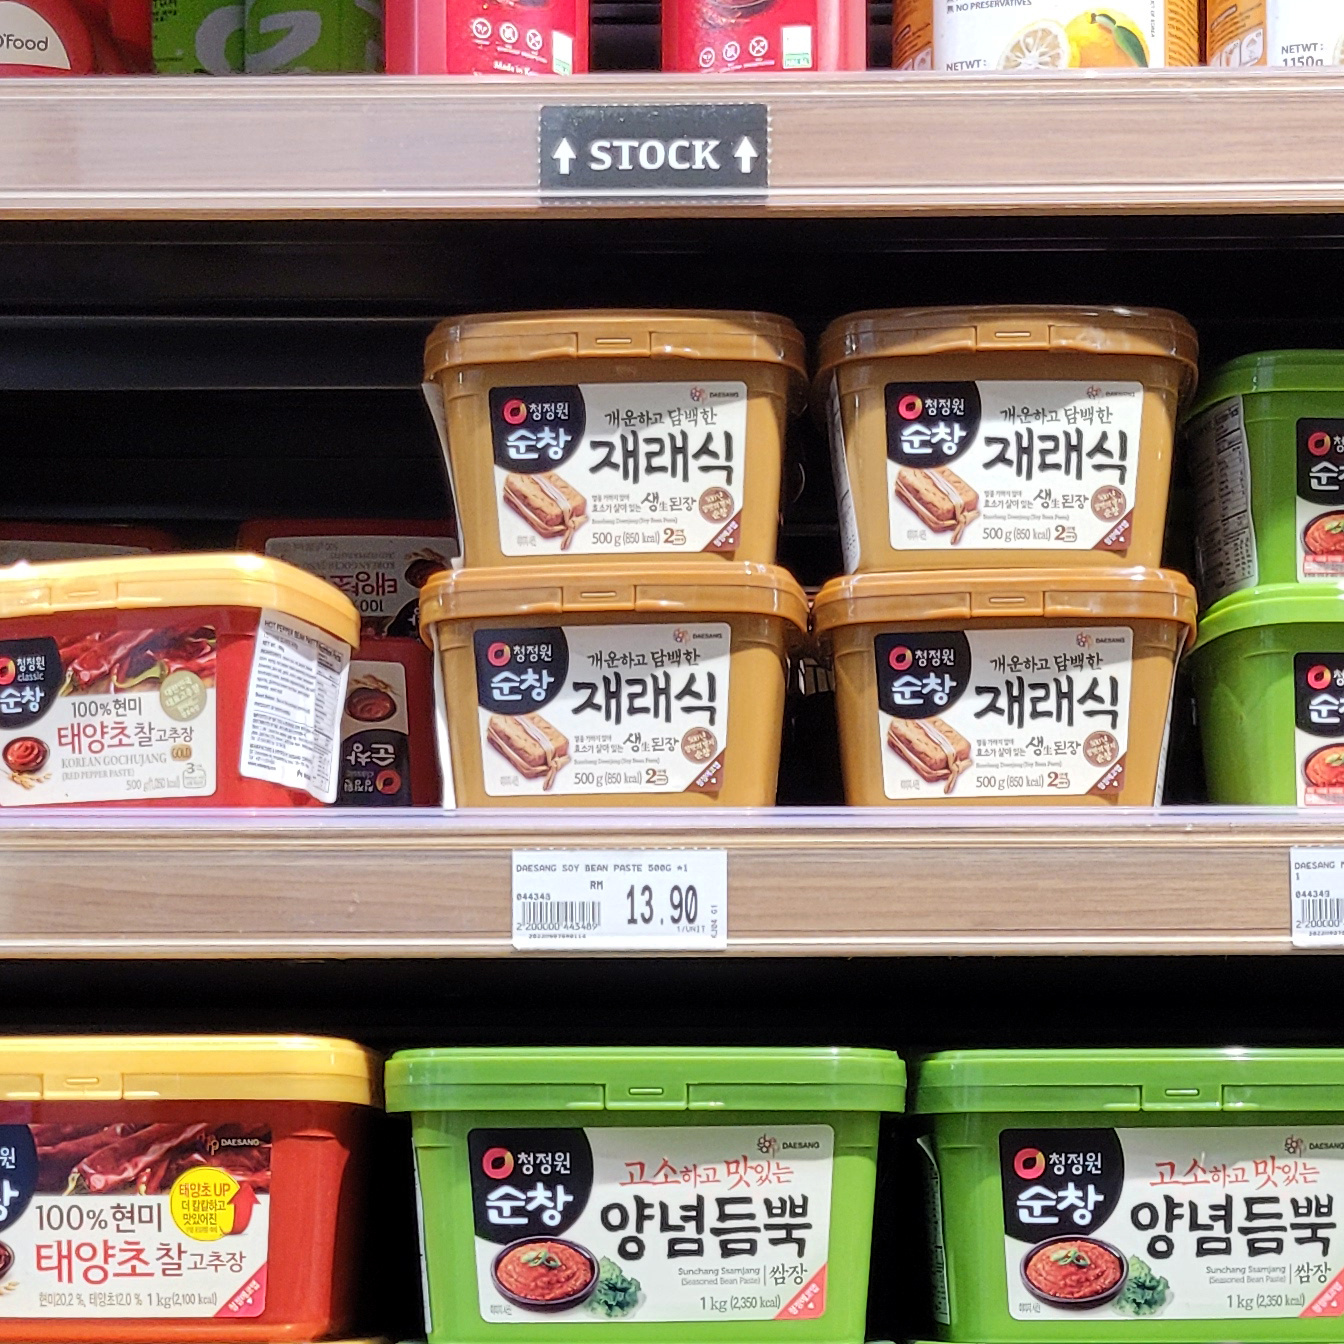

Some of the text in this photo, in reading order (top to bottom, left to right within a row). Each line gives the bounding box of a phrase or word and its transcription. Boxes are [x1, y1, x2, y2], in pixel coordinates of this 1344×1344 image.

[588, 137, 721, 171] STOCK
[528, 401, 569, 421] 청정원
[604, 407, 718, 429] 개운하고 담백한
[507, 428, 574, 461] 순창
[589, 429, 734, 487] 재래식
[982, 427, 1129, 486] 재래식
[16, 656, 47, 673] 청정원
[0, 685, 46, 714] 순창
[489, 668, 555, 702] 순창
[570, 670, 717, 728] 재래식
[891, 673, 958, 706] 순창
[974, 673, 1120, 731] 재래식
[515, 864, 558, 873] DAESANG
[561, 864, 580, 873] SOY
[584, 864, 609, 873] BEAN
[613, 864, 643, 873] PASTE
[589, 880, 605, 891] RM
[625, 884, 699, 926] 13.90
[724, 1155, 795, 1190] 맛있는
[485, 1183, 574, 1227] 순창
[599, 1193, 813, 1261] 양념듬뿍
[1130, 1193, 1337, 1260] 양념듬뿍
